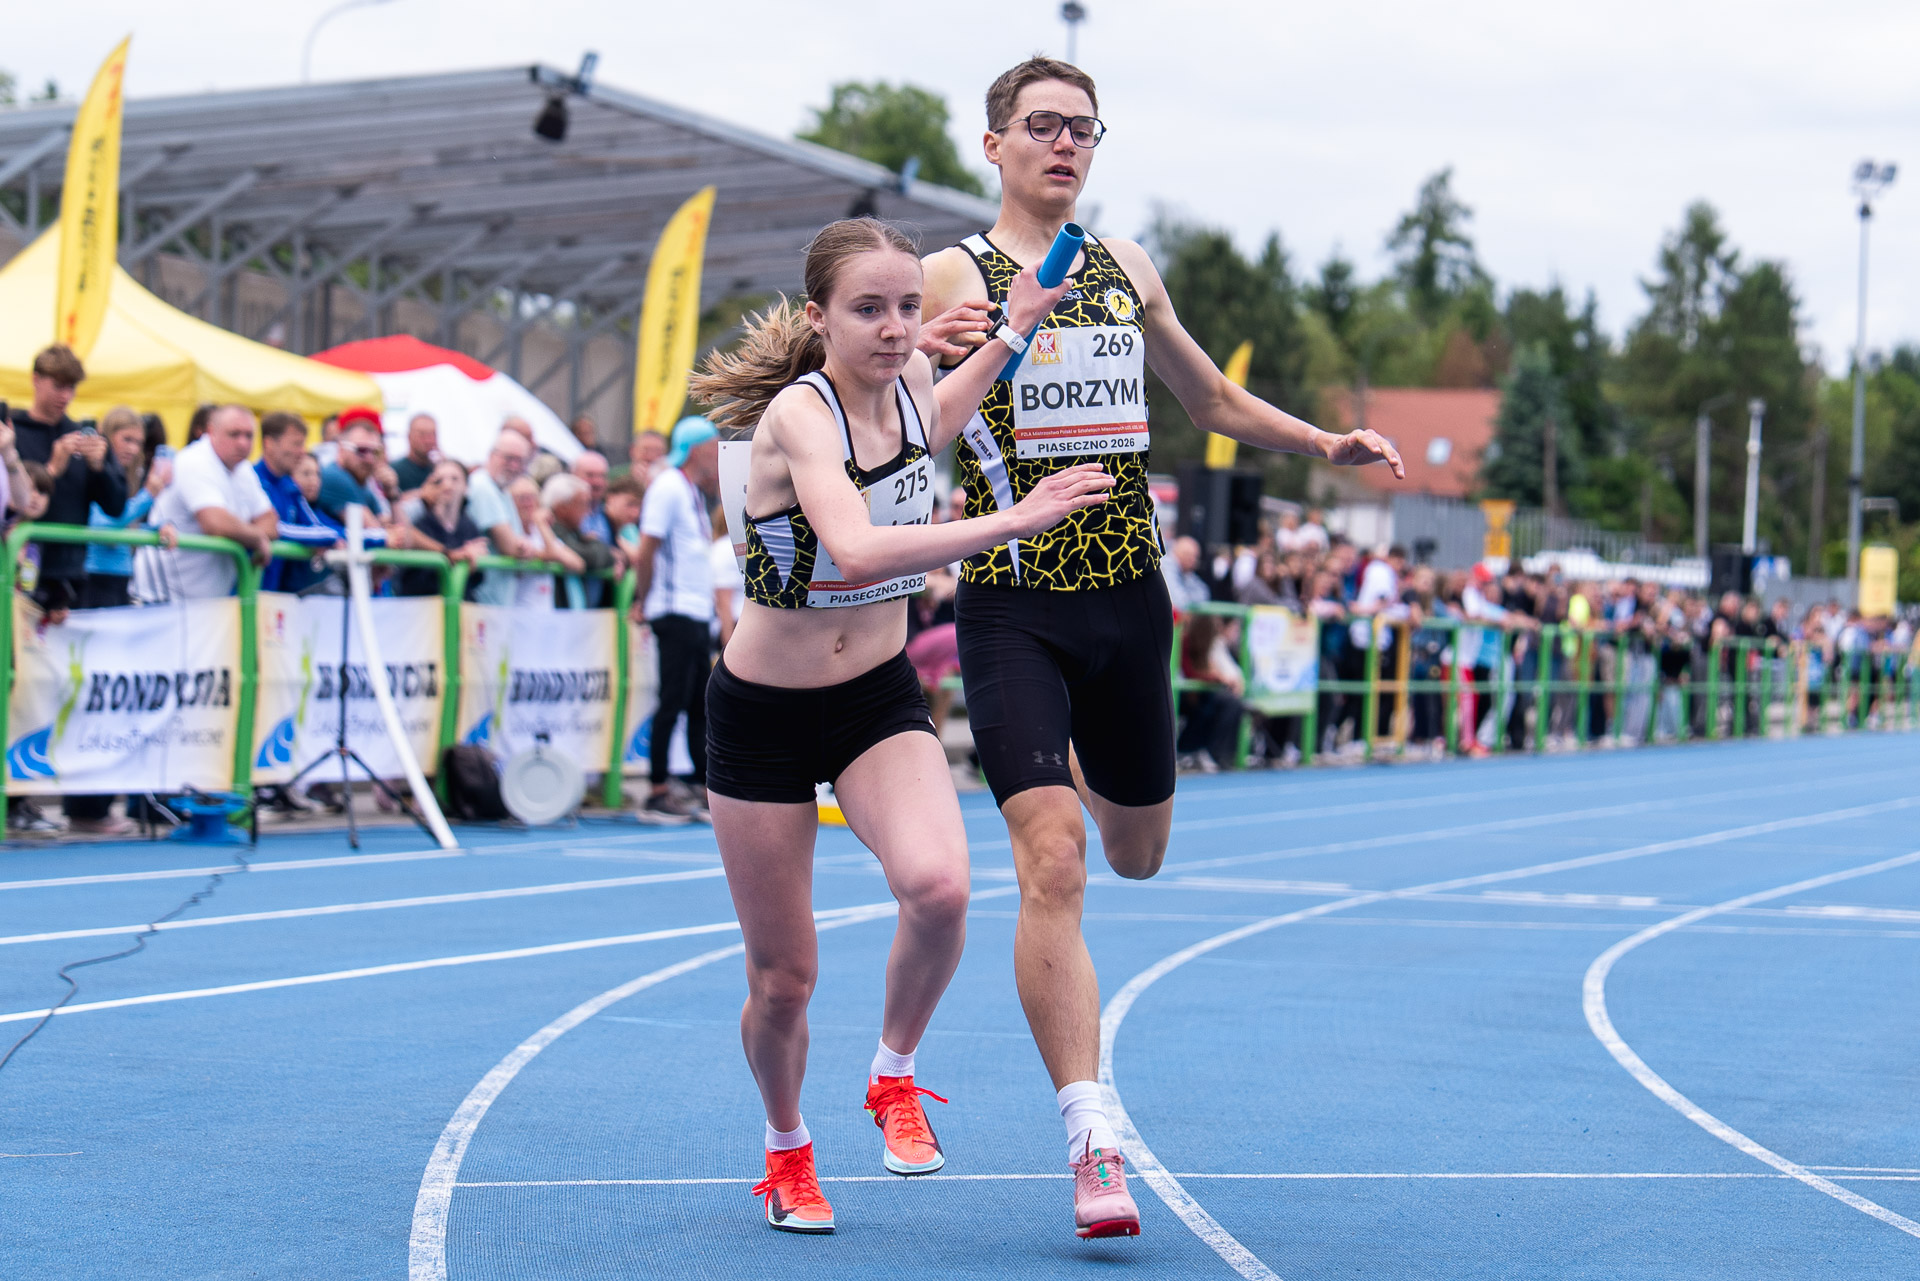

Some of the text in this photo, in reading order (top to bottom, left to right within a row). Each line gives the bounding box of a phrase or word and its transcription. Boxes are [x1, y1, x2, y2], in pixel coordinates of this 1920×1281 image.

[1092, 333, 1134, 357] 269
[1034, 353, 1060, 363] PZLA
[1020, 378, 1138, 411] BORZYM
[1038, 438, 1135, 453] PIASECZNO 2026
[895, 465, 928, 505] 275
[830, 583, 899, 603] PIASECZNO
